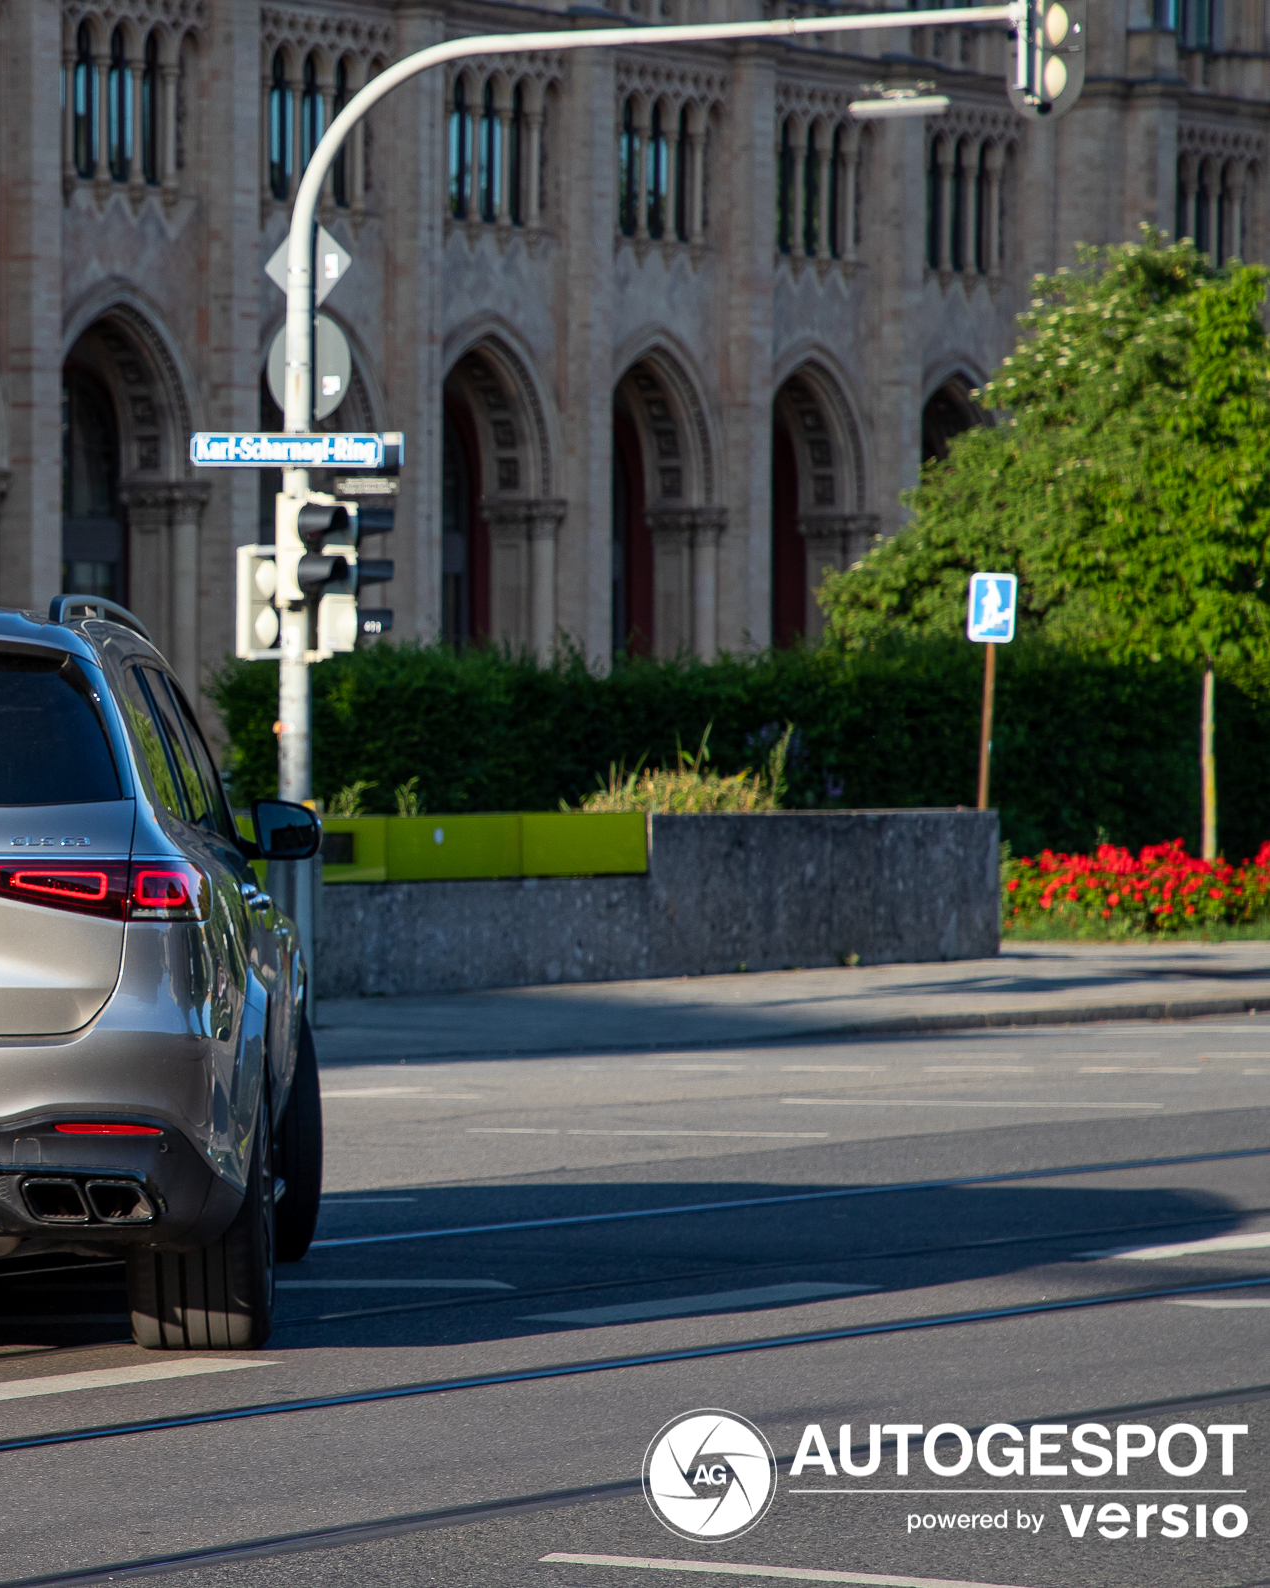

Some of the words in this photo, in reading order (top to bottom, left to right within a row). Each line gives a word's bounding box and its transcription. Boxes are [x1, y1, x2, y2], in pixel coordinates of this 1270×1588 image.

[196, 436, 377, 464] Karl-Scharnagl-Ring
[10, 836, 55, 847] GLS
[60, 836, 91, 847] 63
